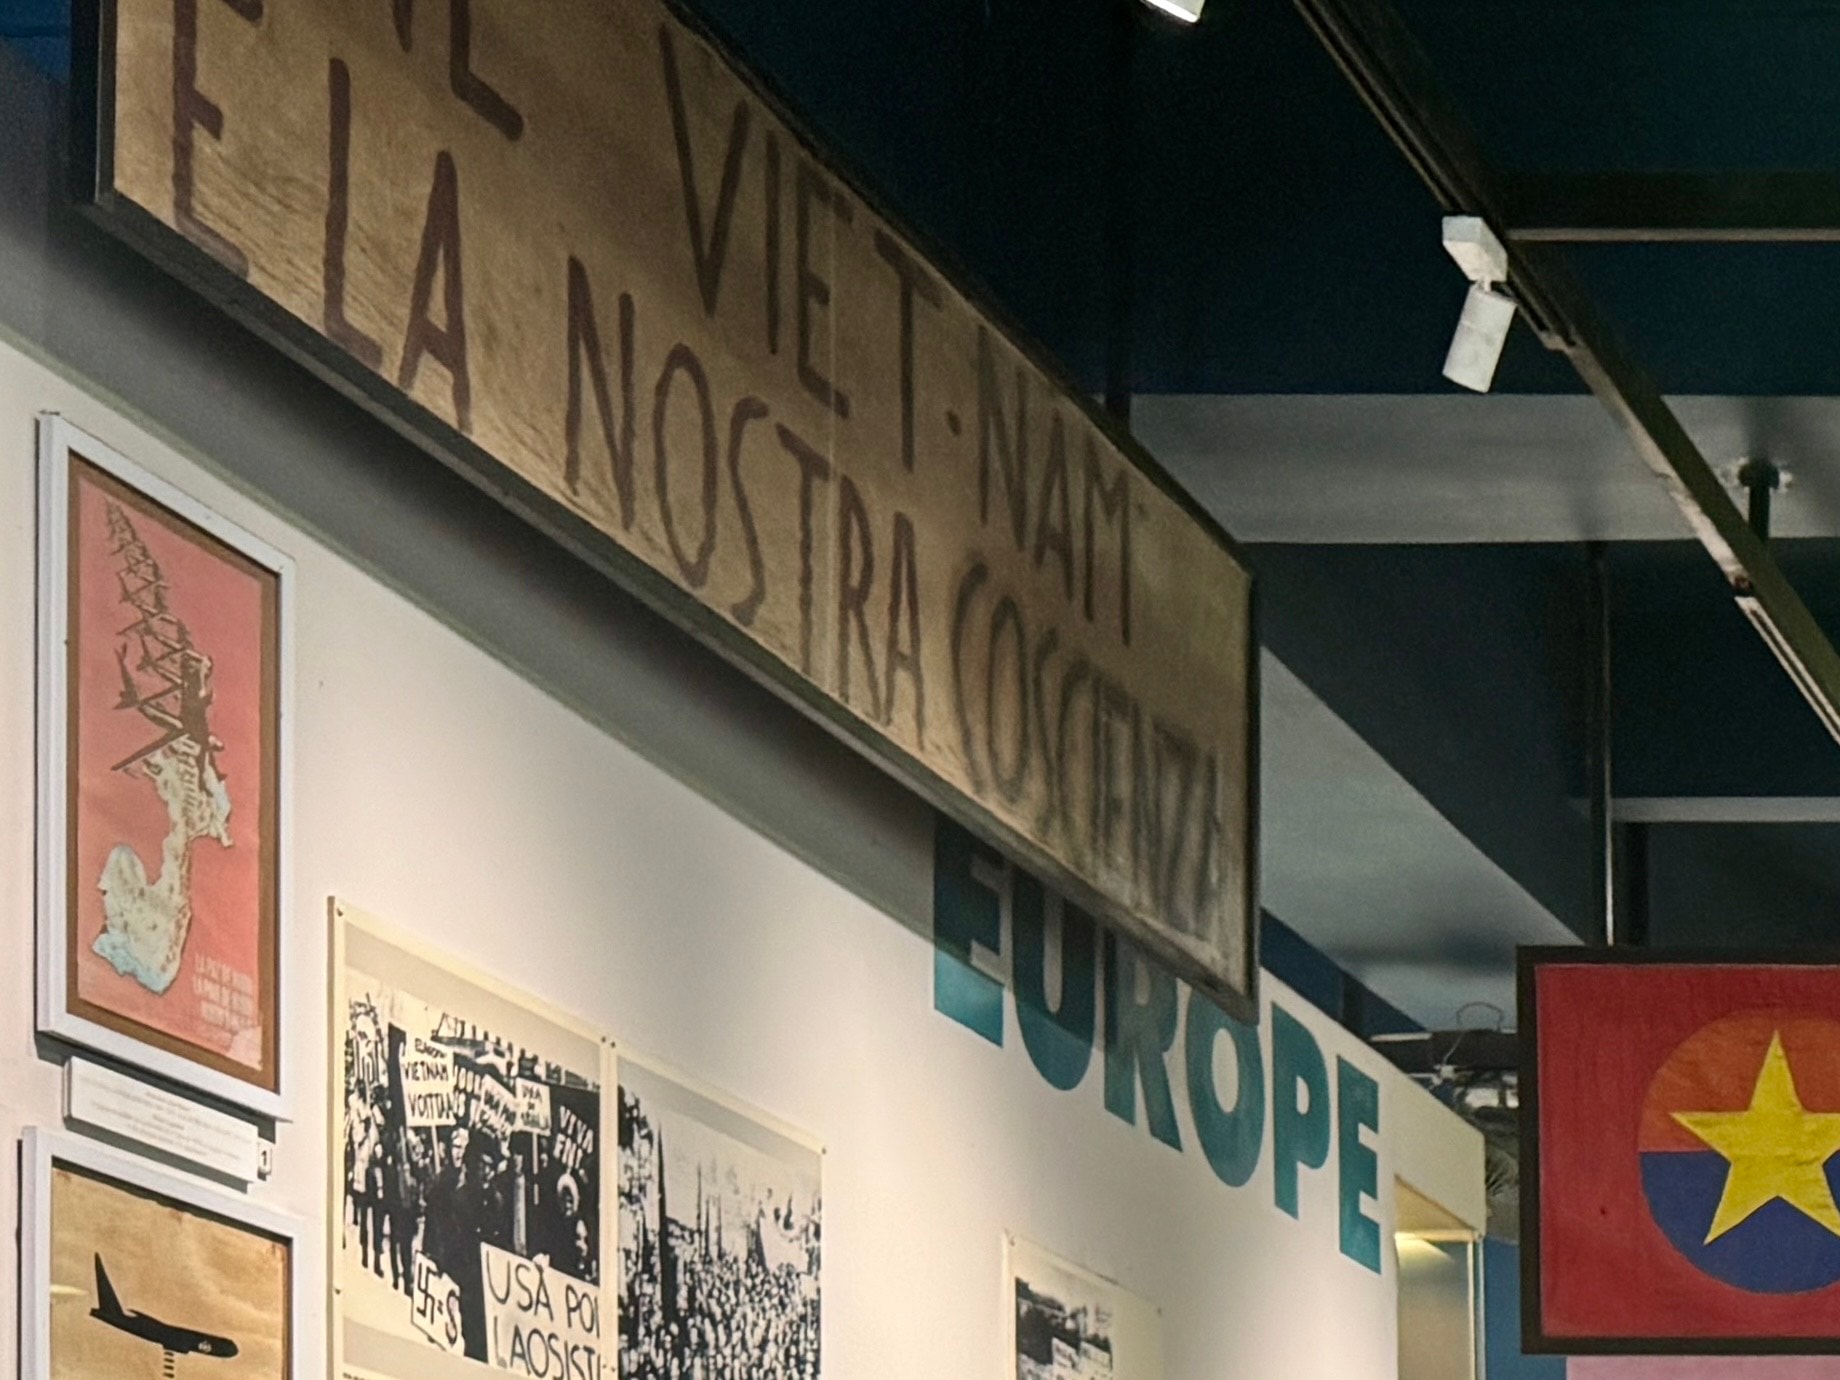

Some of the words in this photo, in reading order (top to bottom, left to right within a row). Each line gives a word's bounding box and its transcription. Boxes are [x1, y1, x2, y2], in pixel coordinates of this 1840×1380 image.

[323, 57, 473, 437] LA
[566, 254, 928, 750] NOSTRA
[934, 805, 1382, 1276] EUROPE
[487, 1251, 553, 1321] USA
